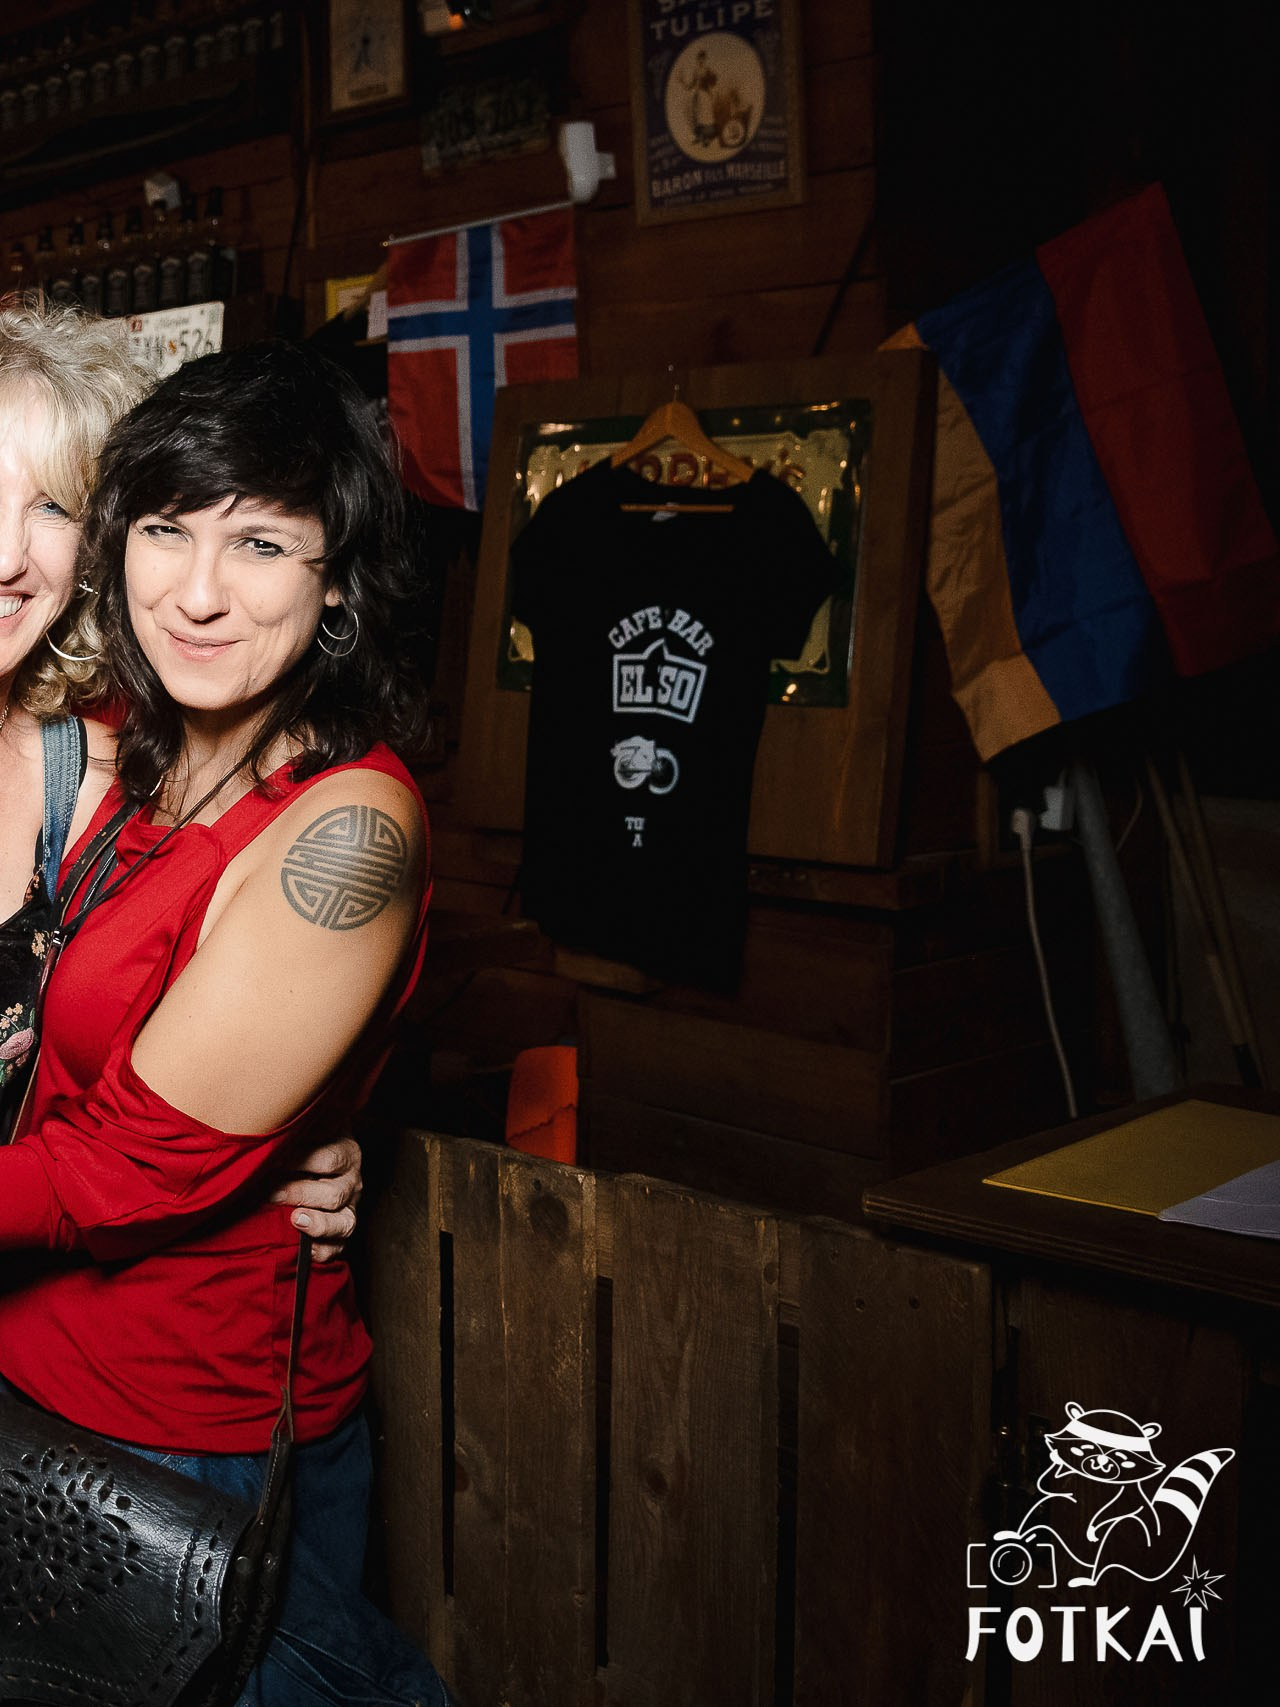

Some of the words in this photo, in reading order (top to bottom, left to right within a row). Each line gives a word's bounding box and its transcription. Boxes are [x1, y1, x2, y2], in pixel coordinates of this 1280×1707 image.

[649, 0, 775, 41] TULIPE
[607, 605, 663, 650] CAFE
[666, 607, 715, 658] BAR
[619, 663, 654, 704] EL
